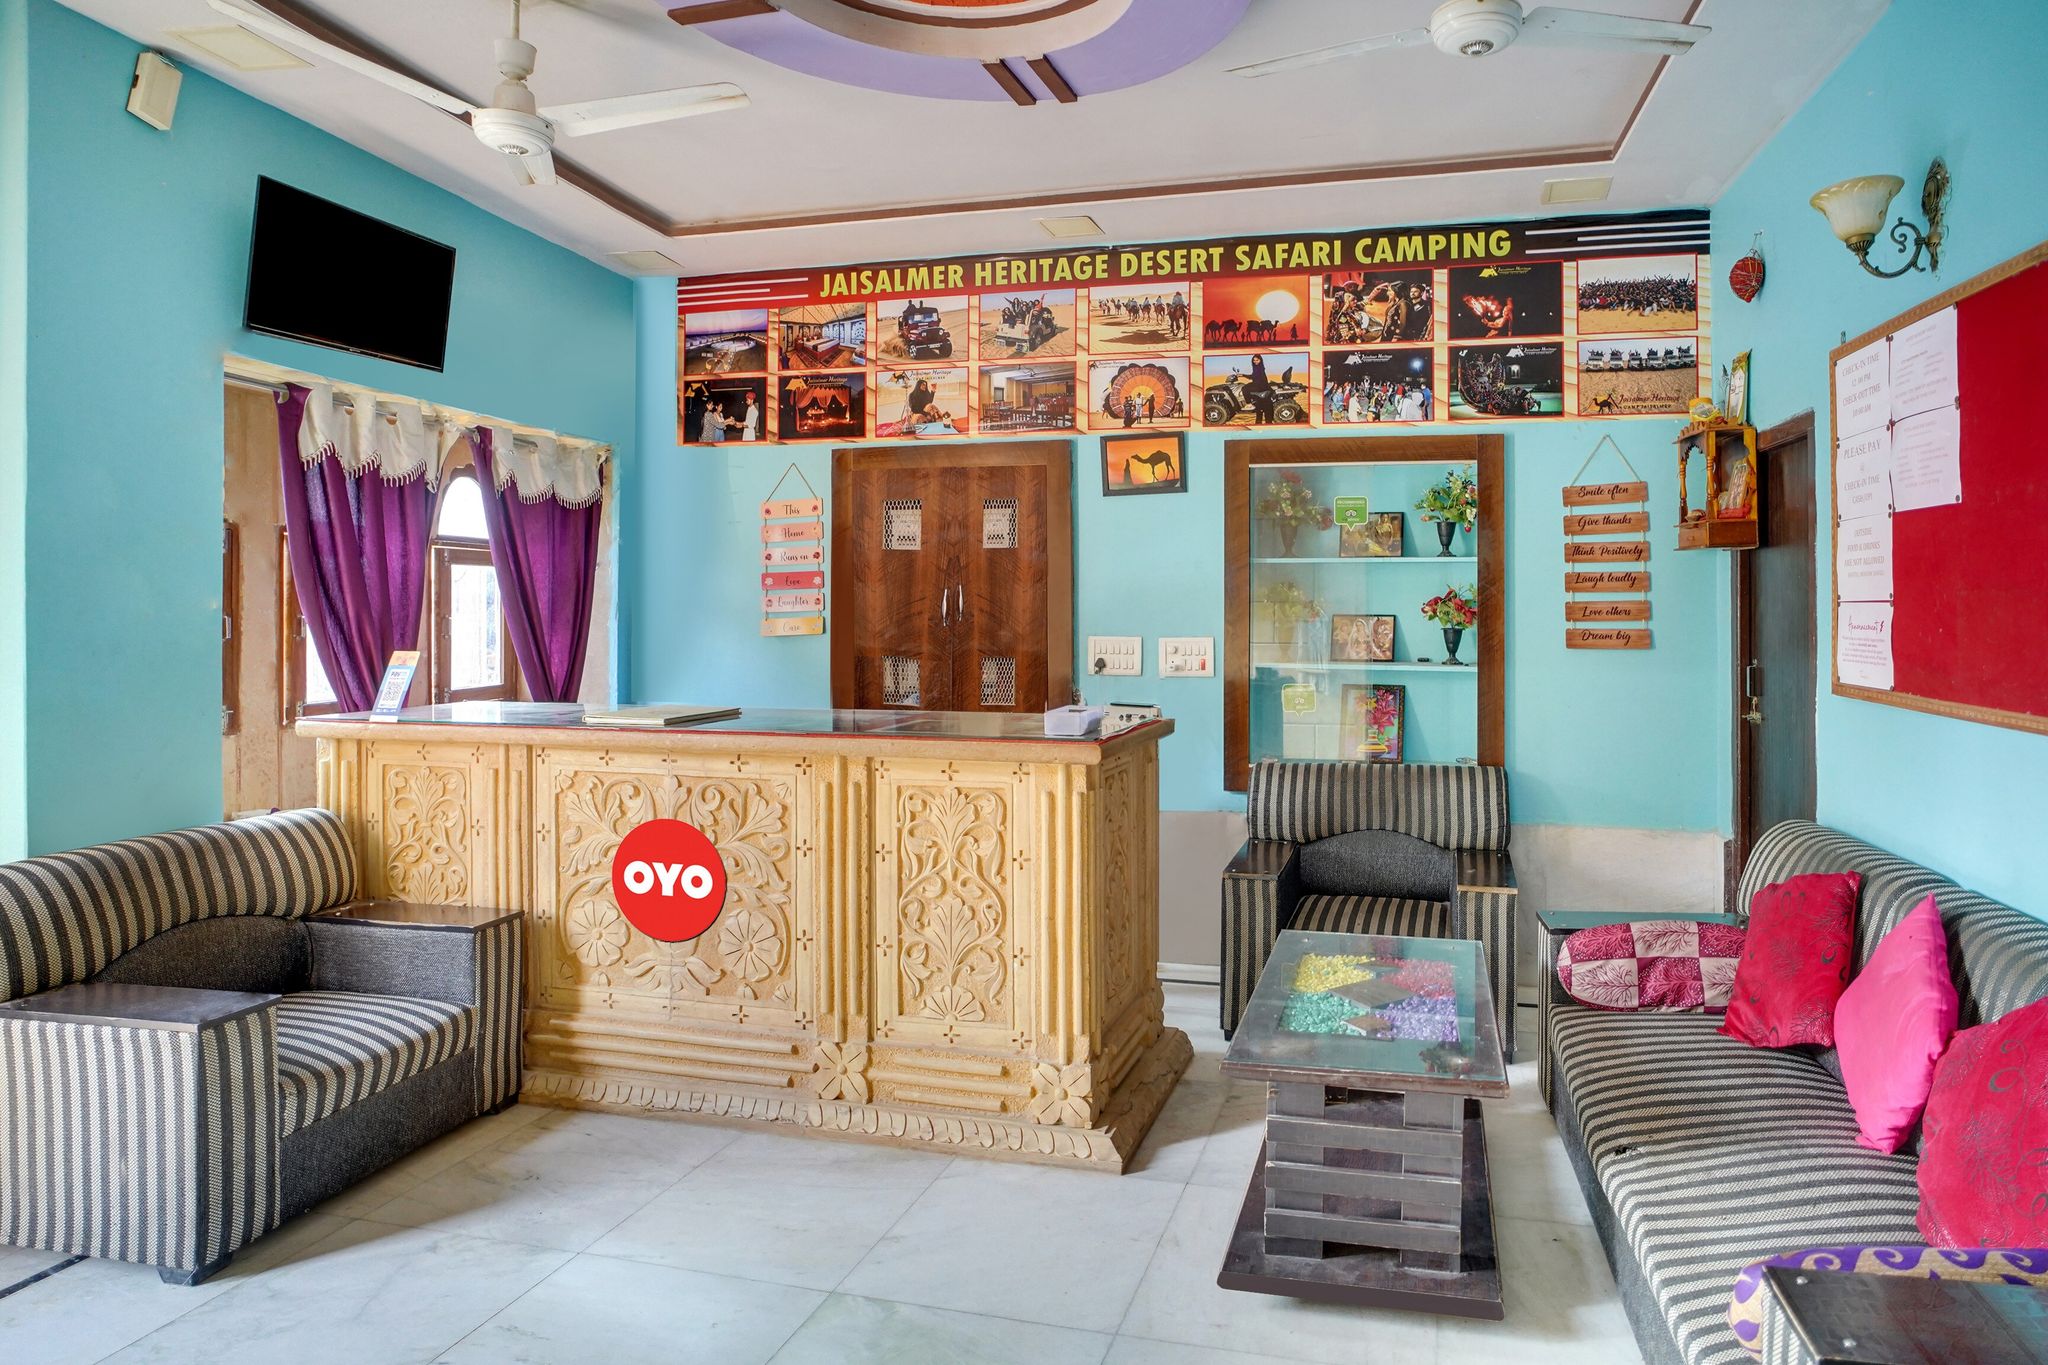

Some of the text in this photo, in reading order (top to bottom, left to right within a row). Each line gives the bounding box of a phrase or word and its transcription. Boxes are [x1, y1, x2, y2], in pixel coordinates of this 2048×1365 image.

[820, 230, 1511, 297] JAISALMER HERITAGE DESERT SAFARI CAMPING
[1844, 438, 1882, 460] PLEASE PAY
[1577, 485, 1629, 500] Smile often
[784, 505, 800, 516] This
[1578, 514, 1633, 531] Give thanks
[784, 527, 804, 538] Home
[1571, 544, 1644, 560] Think Positively
[1574, 572, 1638, 588] Laugh loudly
[777, 595, 809, 609] Laughter
[1582, 605, 1632, 617] Love others
[1581, 629, 1632, 646] Dream big
[623, 860, 714, 899] OYO
